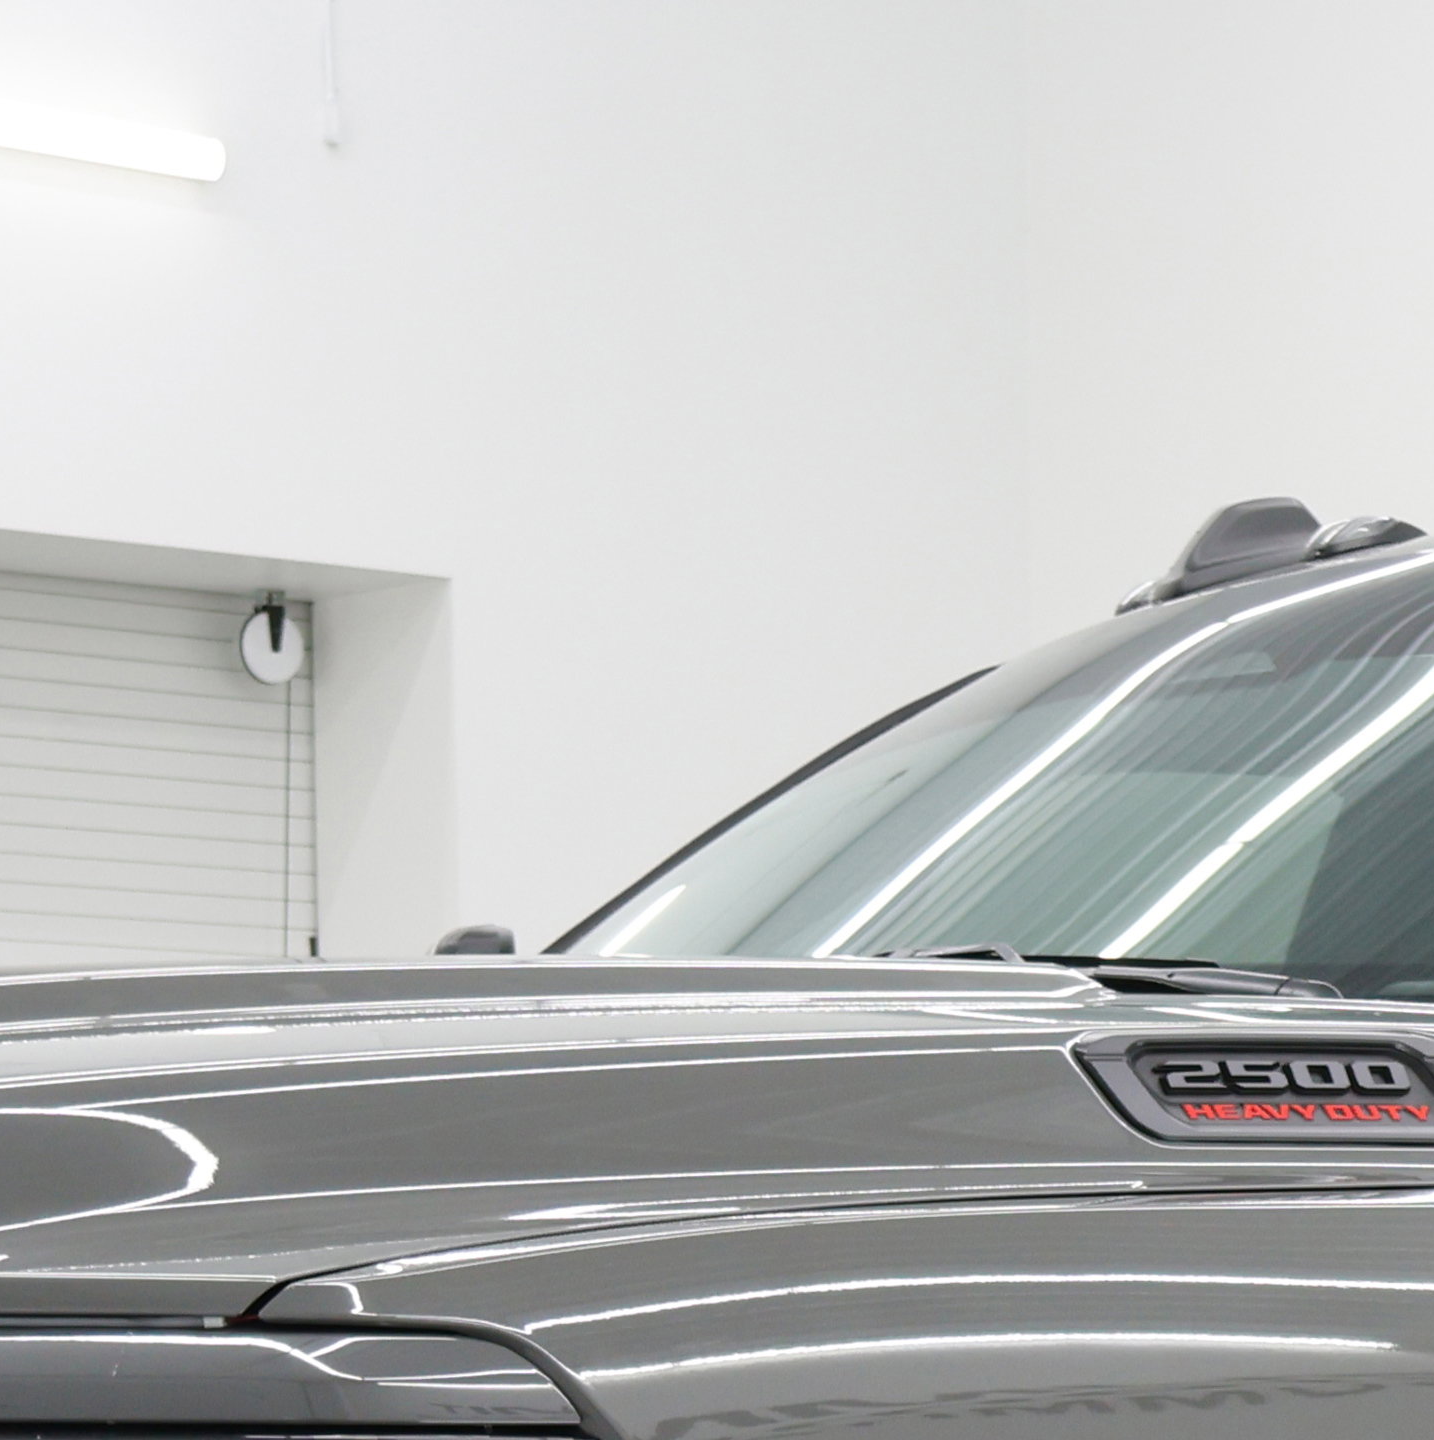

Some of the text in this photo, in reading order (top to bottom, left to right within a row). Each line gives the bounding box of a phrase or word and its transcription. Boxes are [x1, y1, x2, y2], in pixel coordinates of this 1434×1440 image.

[1161, 1059, 1412, 1095] 2500
[1180, 1102, 1430, 1122] HEAVY DUTY
